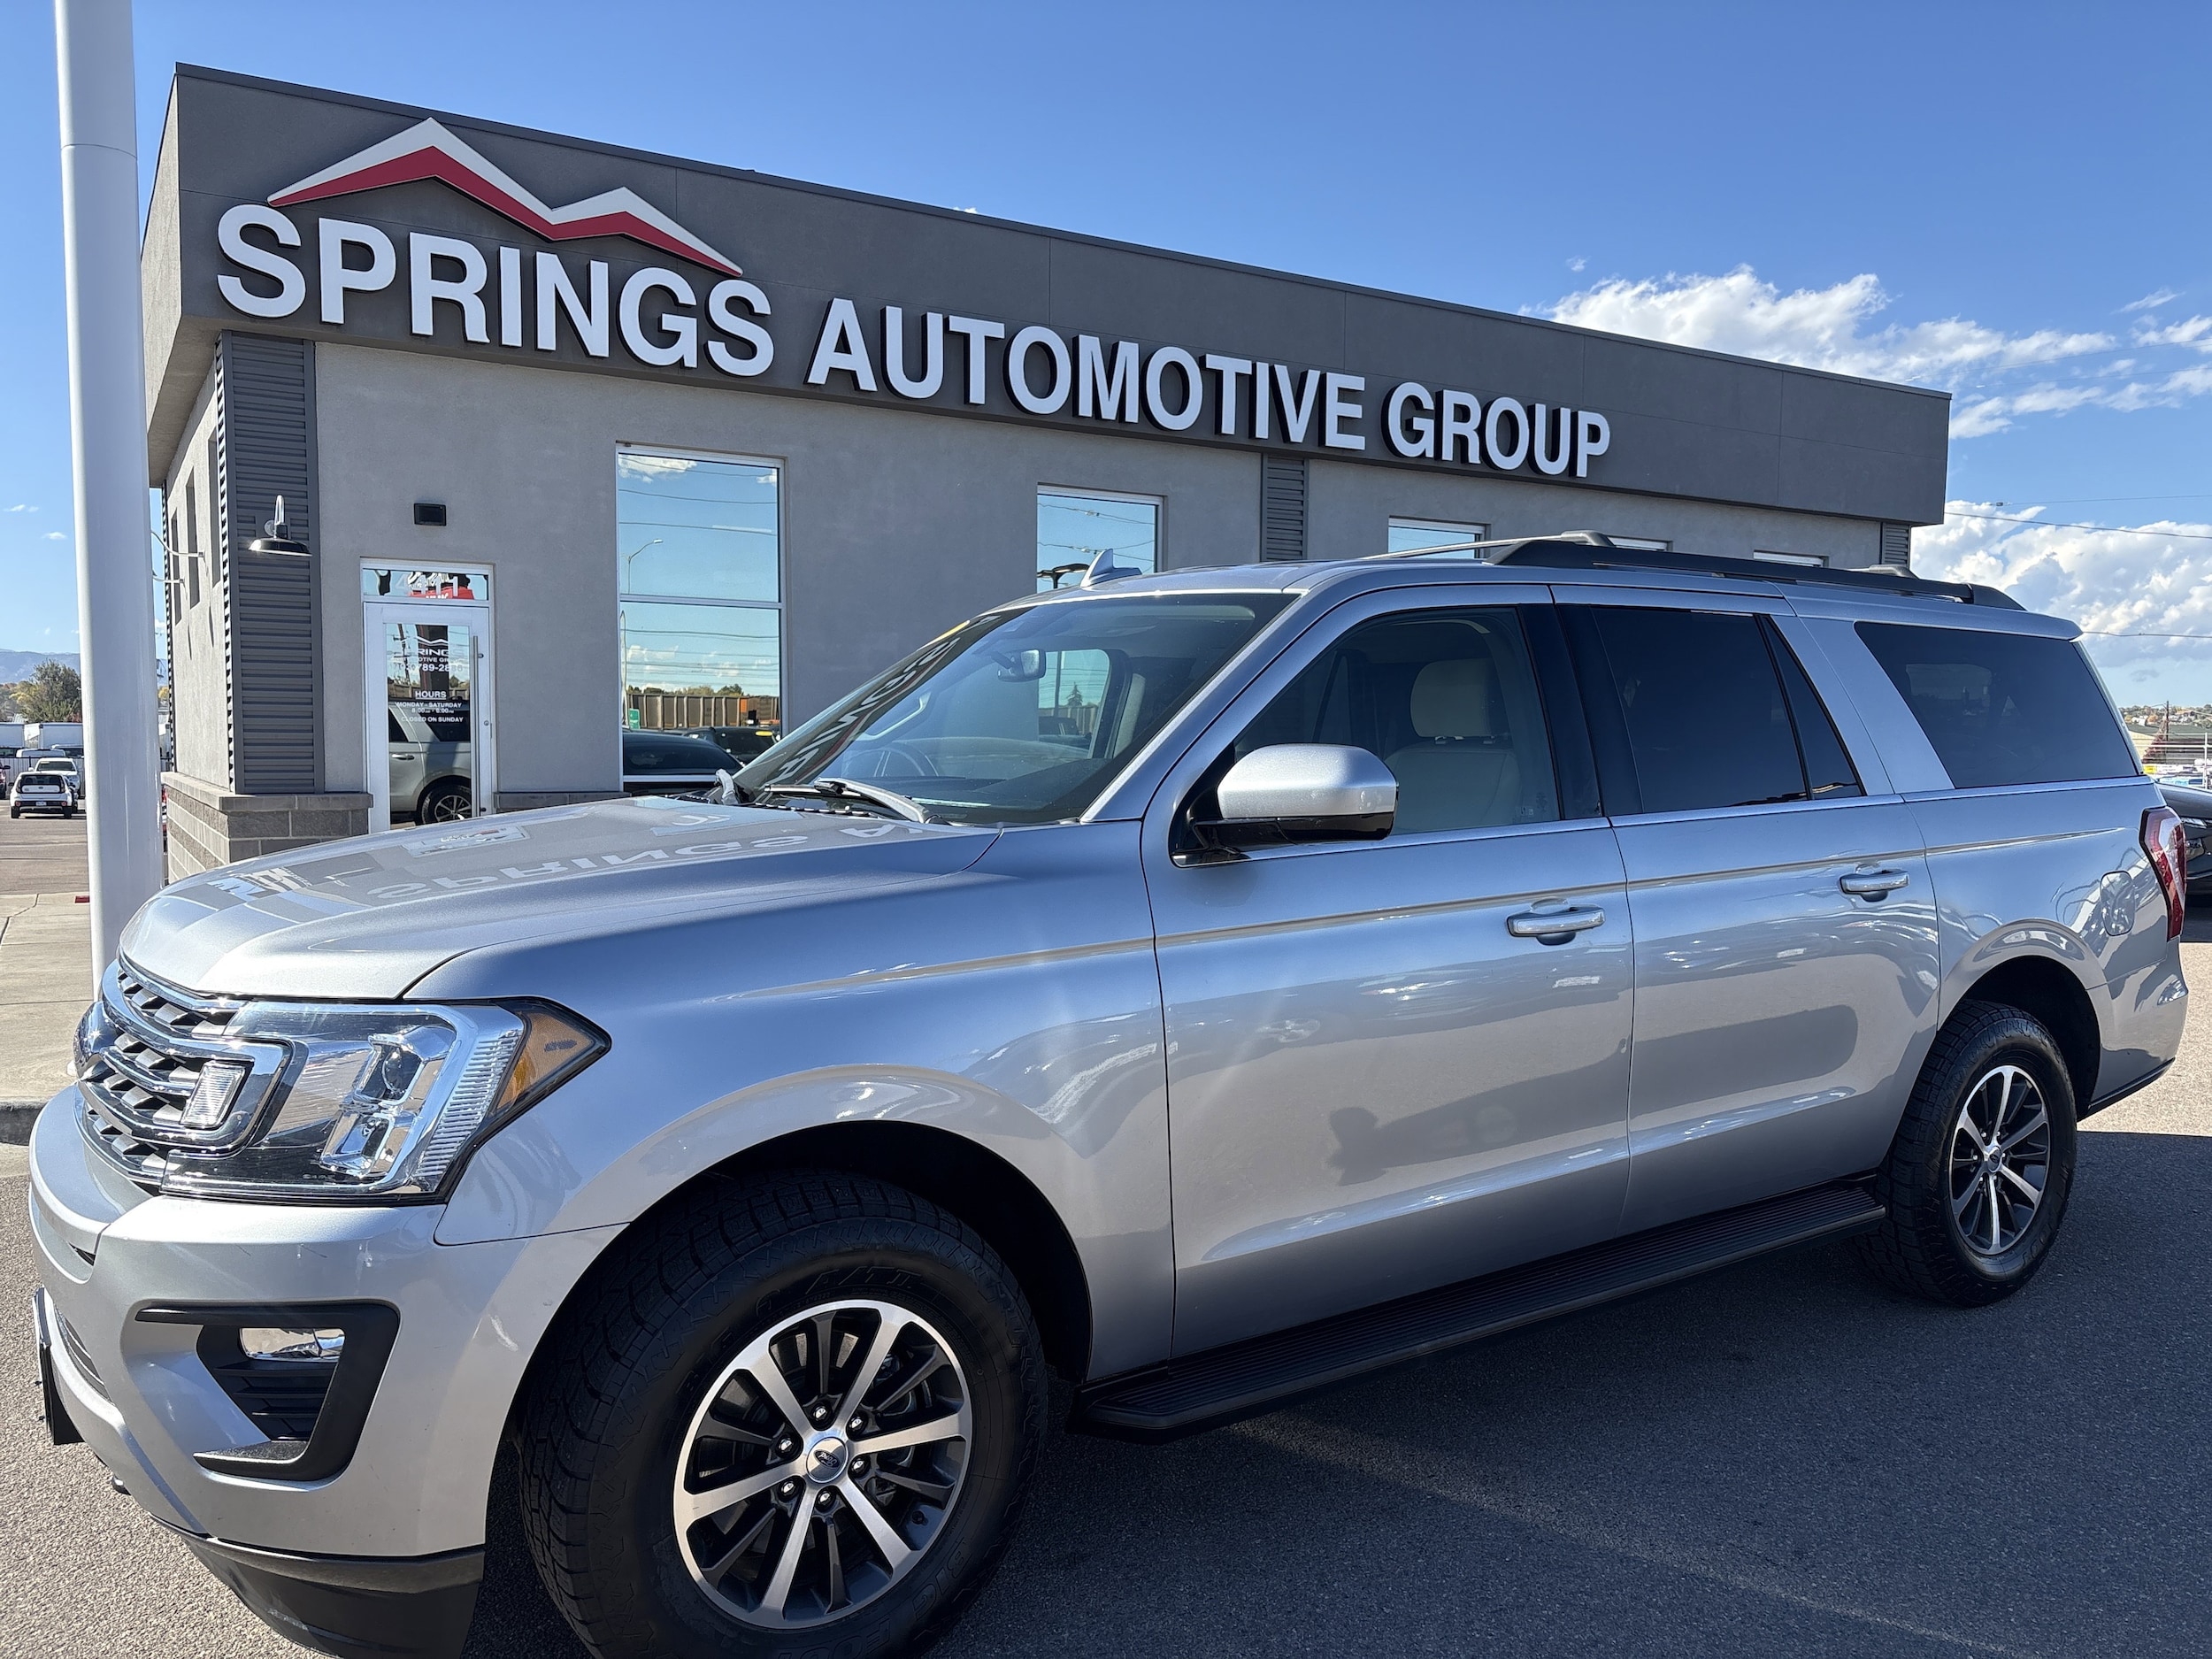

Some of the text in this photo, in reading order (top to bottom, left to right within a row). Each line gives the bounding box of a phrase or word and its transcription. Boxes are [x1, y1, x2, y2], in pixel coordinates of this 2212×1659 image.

[217, 204, 1610, 479] SPRINGS AUTOMOTIVE GROUP
[396, 573, 458, 597] 4411
